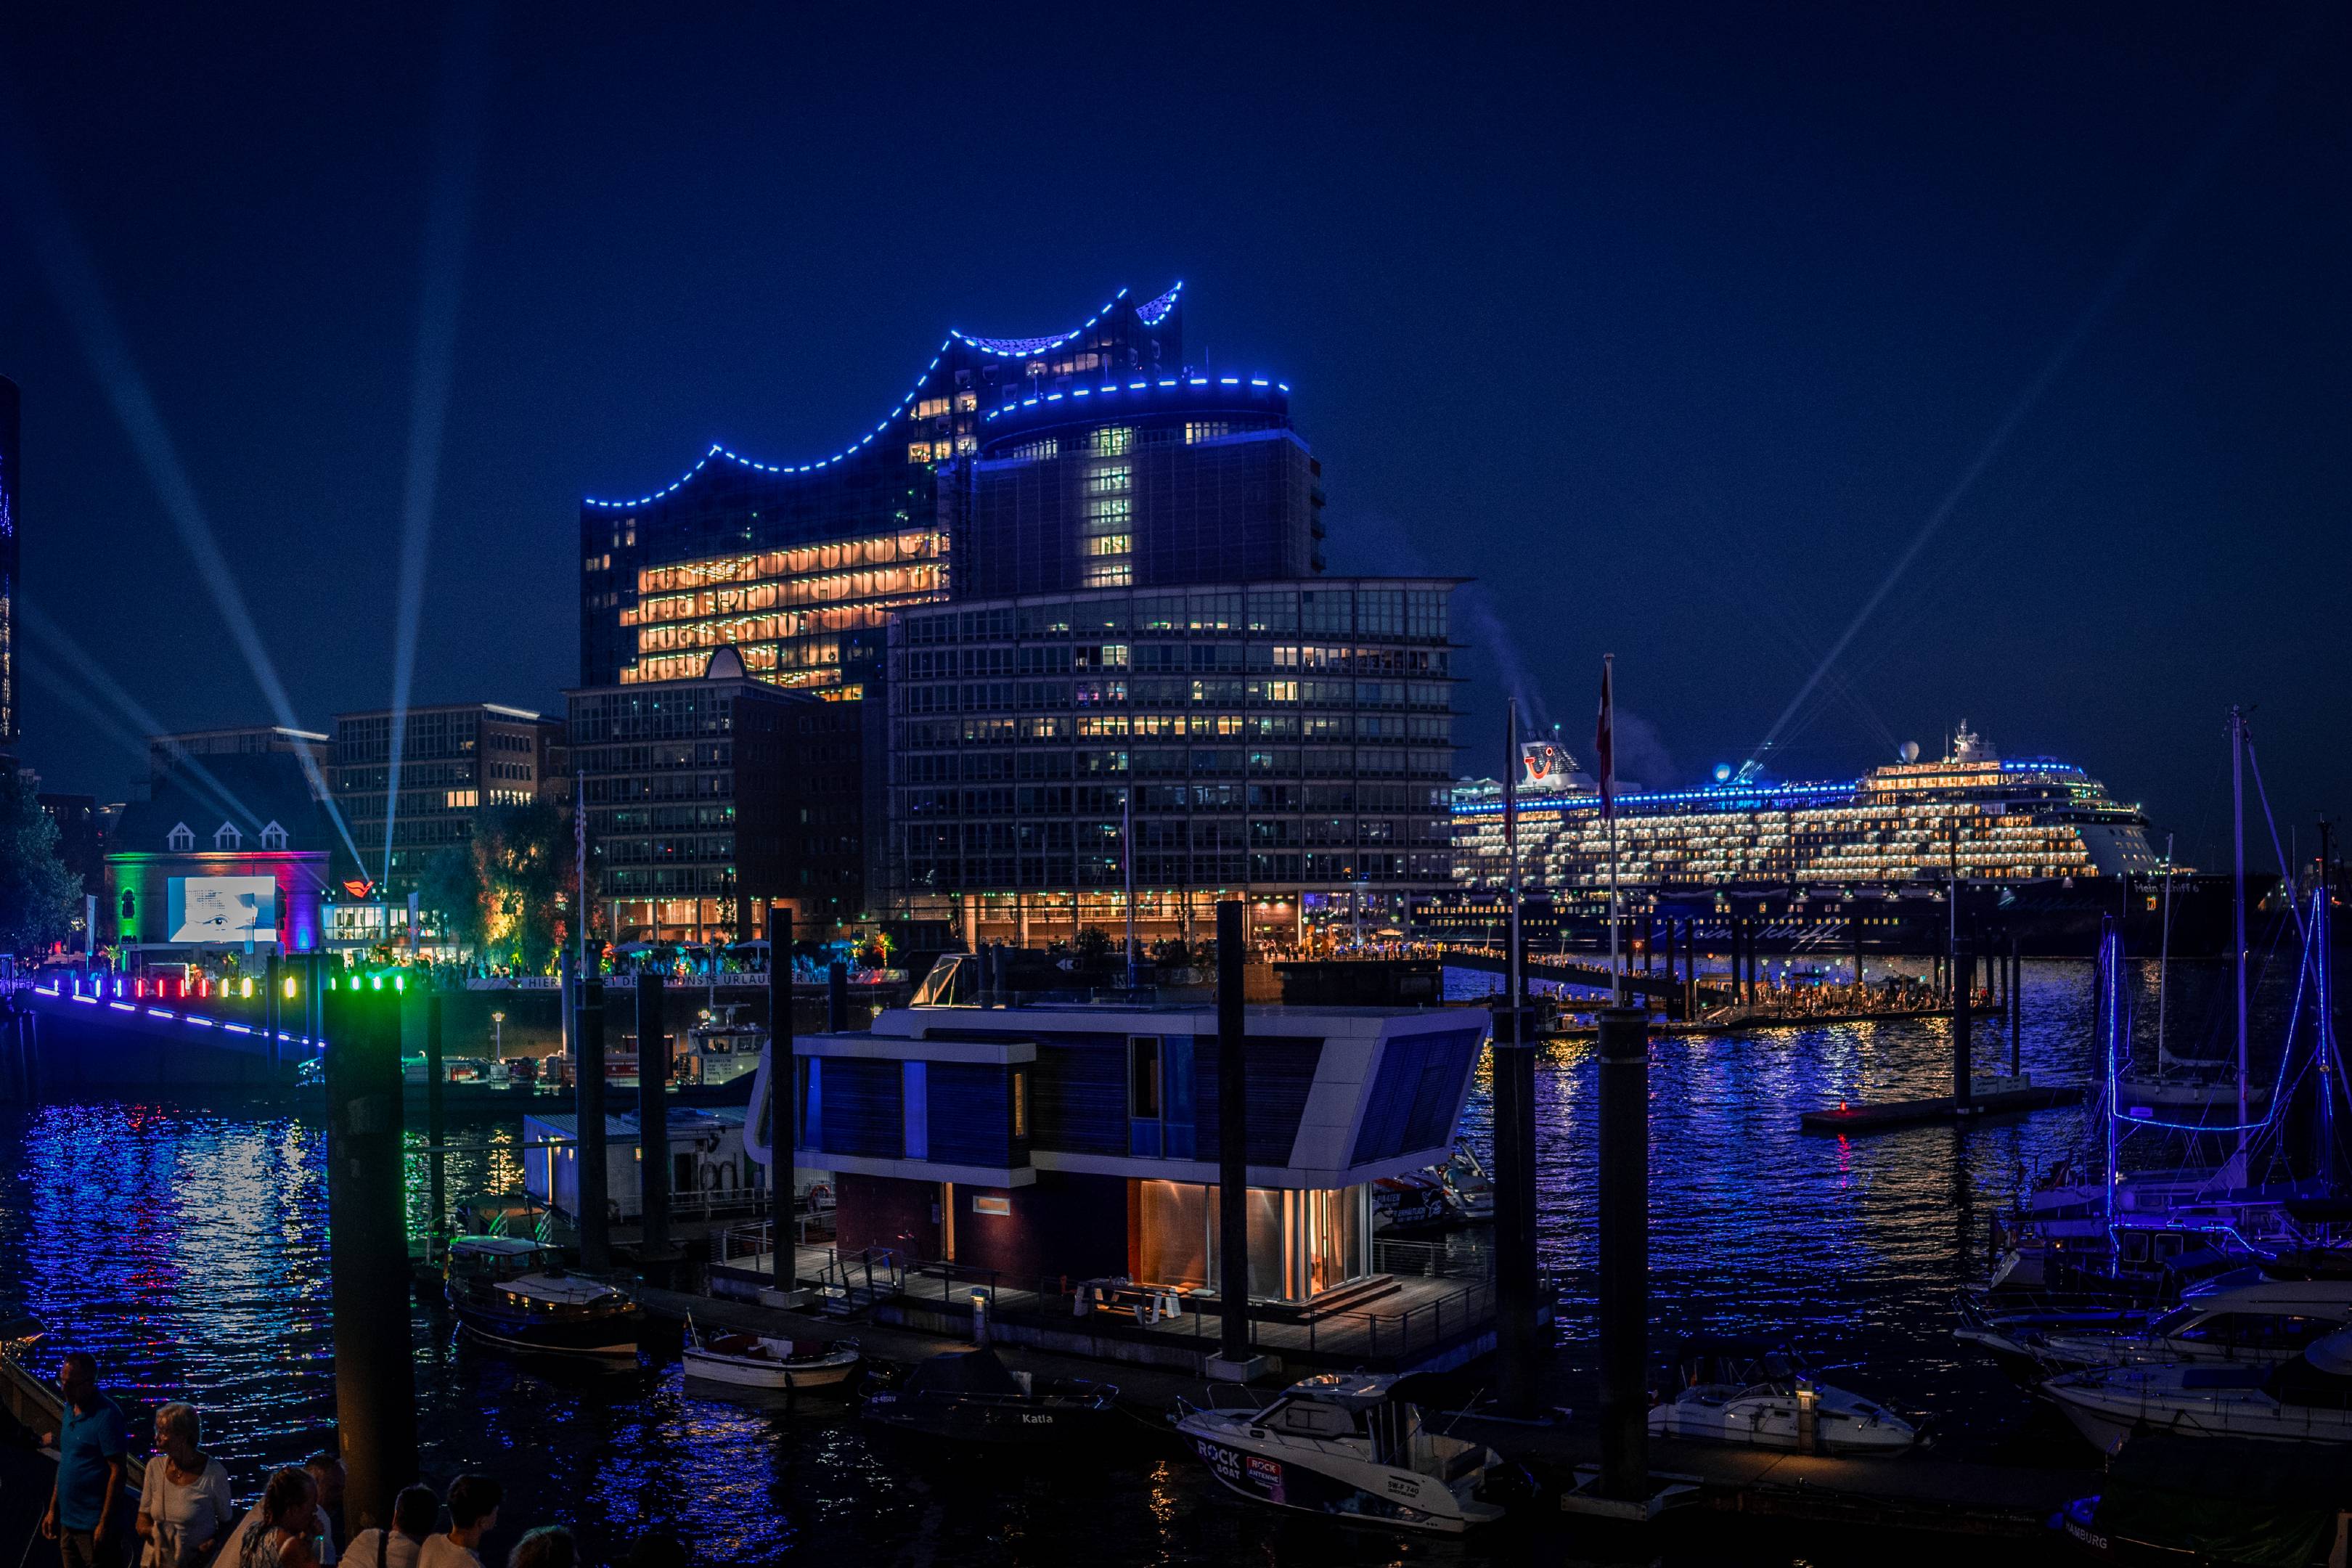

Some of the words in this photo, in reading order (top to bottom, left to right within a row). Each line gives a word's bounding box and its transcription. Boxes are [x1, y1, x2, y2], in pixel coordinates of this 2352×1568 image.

[2134, 883, 2159, 894] Mein
[2160, 883, 2190, 894] Shiff
[2192, 883, 2200, 894] 6
[528, 977, 558, 988] HIER
[1196, 1440, 1240, 1469] ROCK
[1216, 1463, 1240, 1479] BOAT
[1251, 1459, 1276, 1474] ROCK
[1249, 1469, 1278, 1483] ANTENNE
[1406, 1486, 1419, 1495] 740
[2065, 1521, 2108, 1549] HAMBURG
